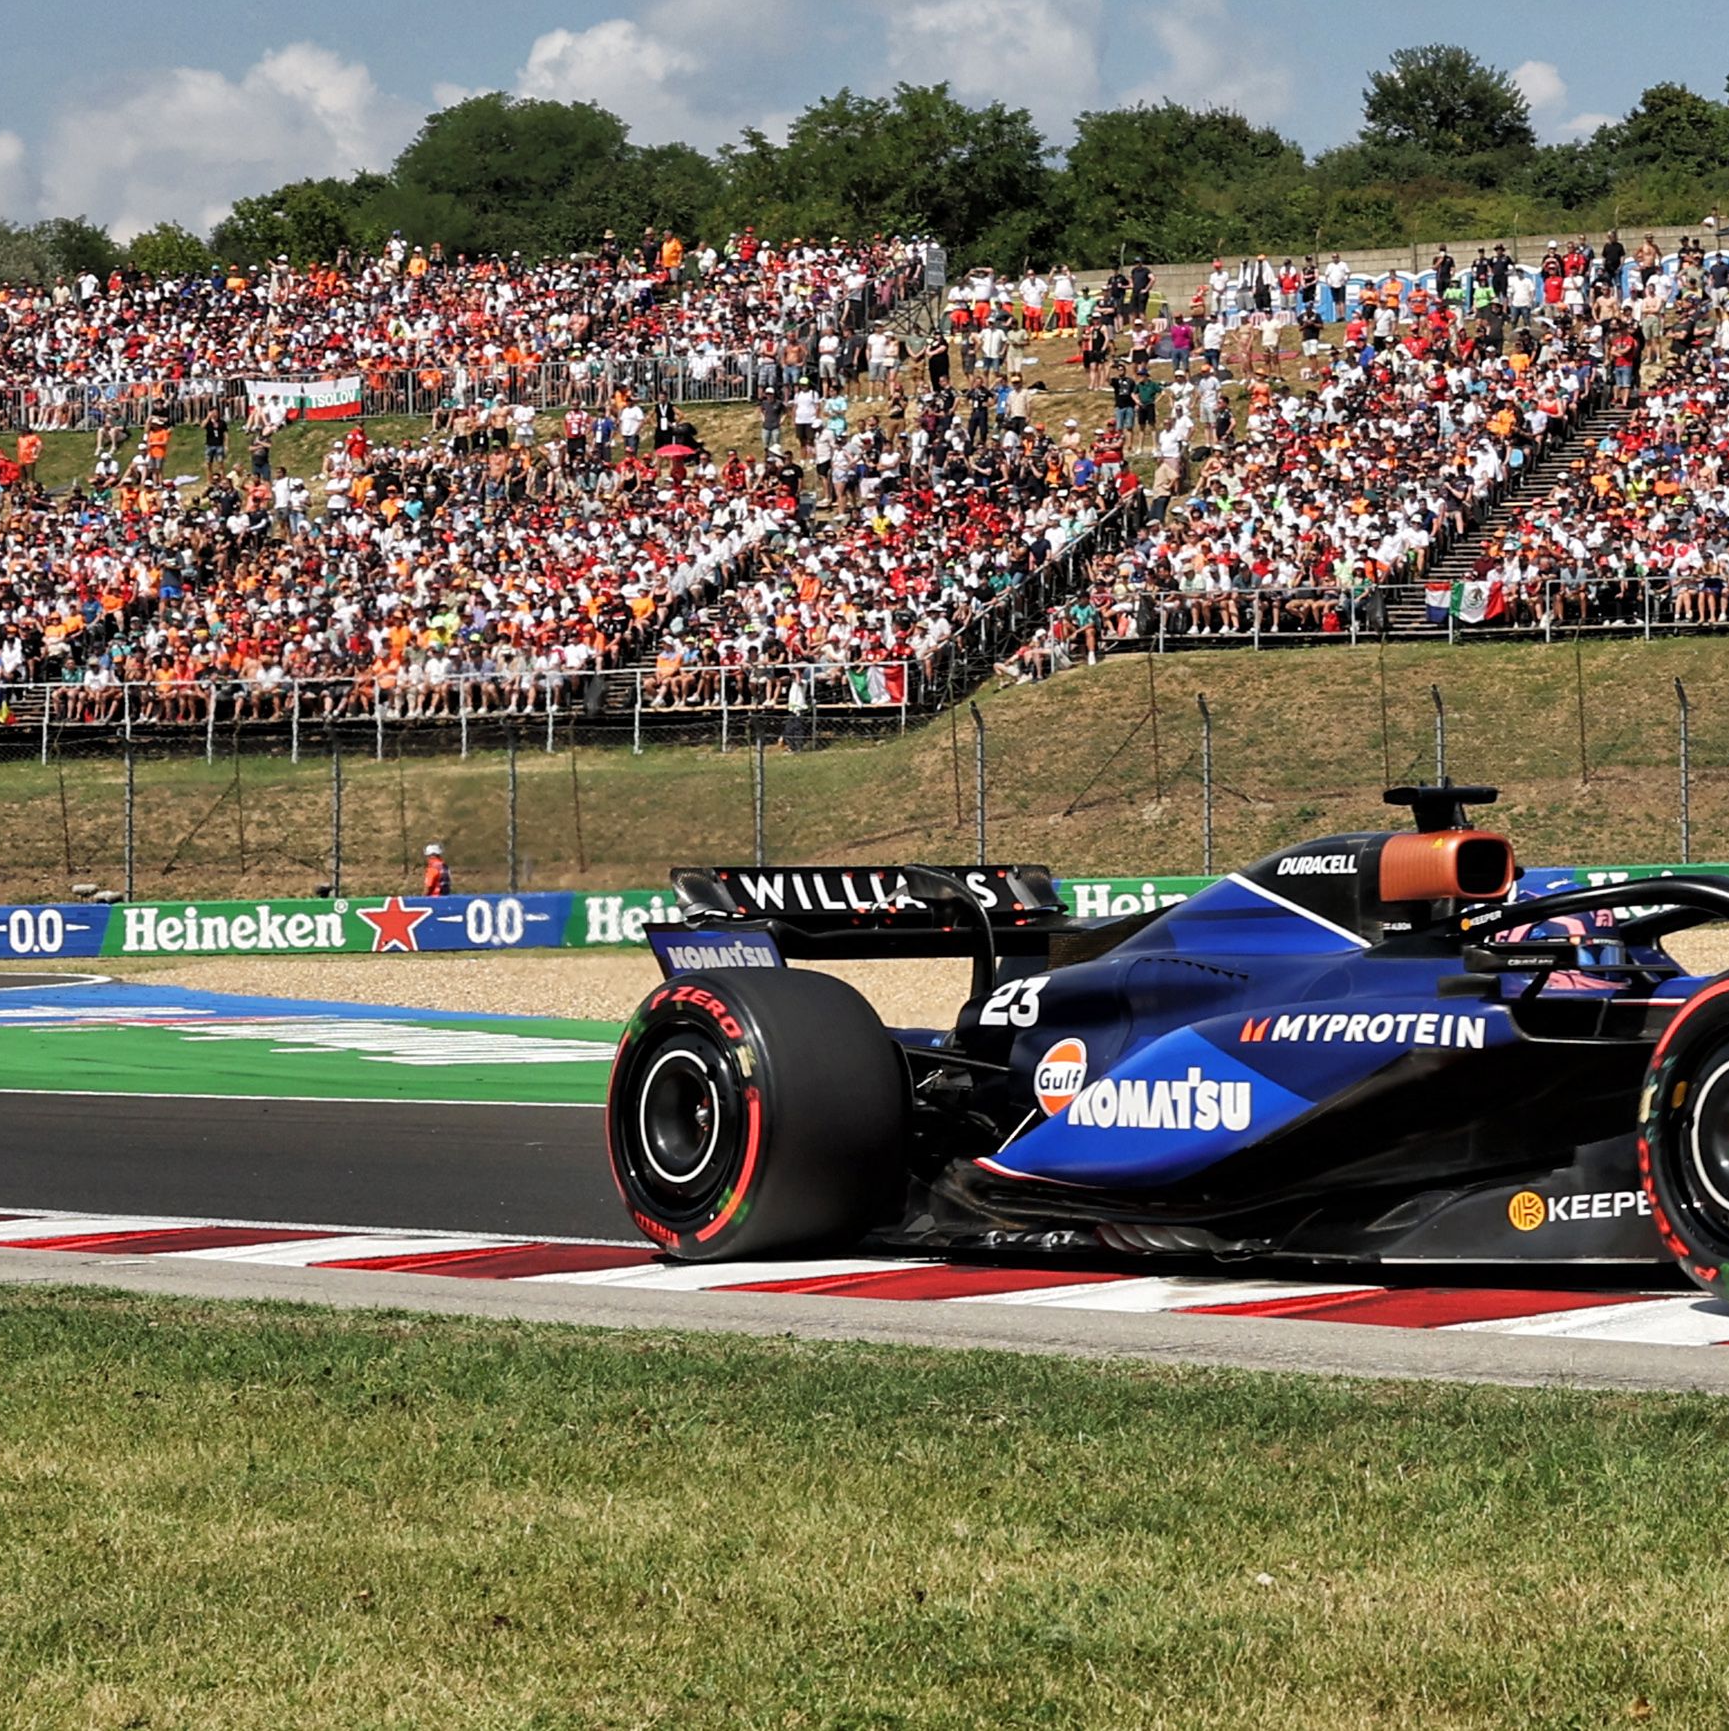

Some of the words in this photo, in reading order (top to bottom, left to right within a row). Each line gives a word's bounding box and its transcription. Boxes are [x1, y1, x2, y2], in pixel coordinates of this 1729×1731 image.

[310, 389, 356, 407] TSOLOV
[1277, 855, 1357, 875] DURACELL
[739, 873, 998, 910] WILLIAS
[8, 909, 63, 953] 0.0
[123, 906, 346, 952] Heineken
[467, 899, 523, 946] 0.0
[667, 941, 775, 968] KOMATSU
[672, 985, 744, 1039] ZERO
[979, 976, 1051, 1027] 23
[1271, 1013, 1486, 1049] MYPROTEIN
[1038, 1069, 1081, 1091] Gulf
[1068, 1067, 1251, 1131] KOMATSU
